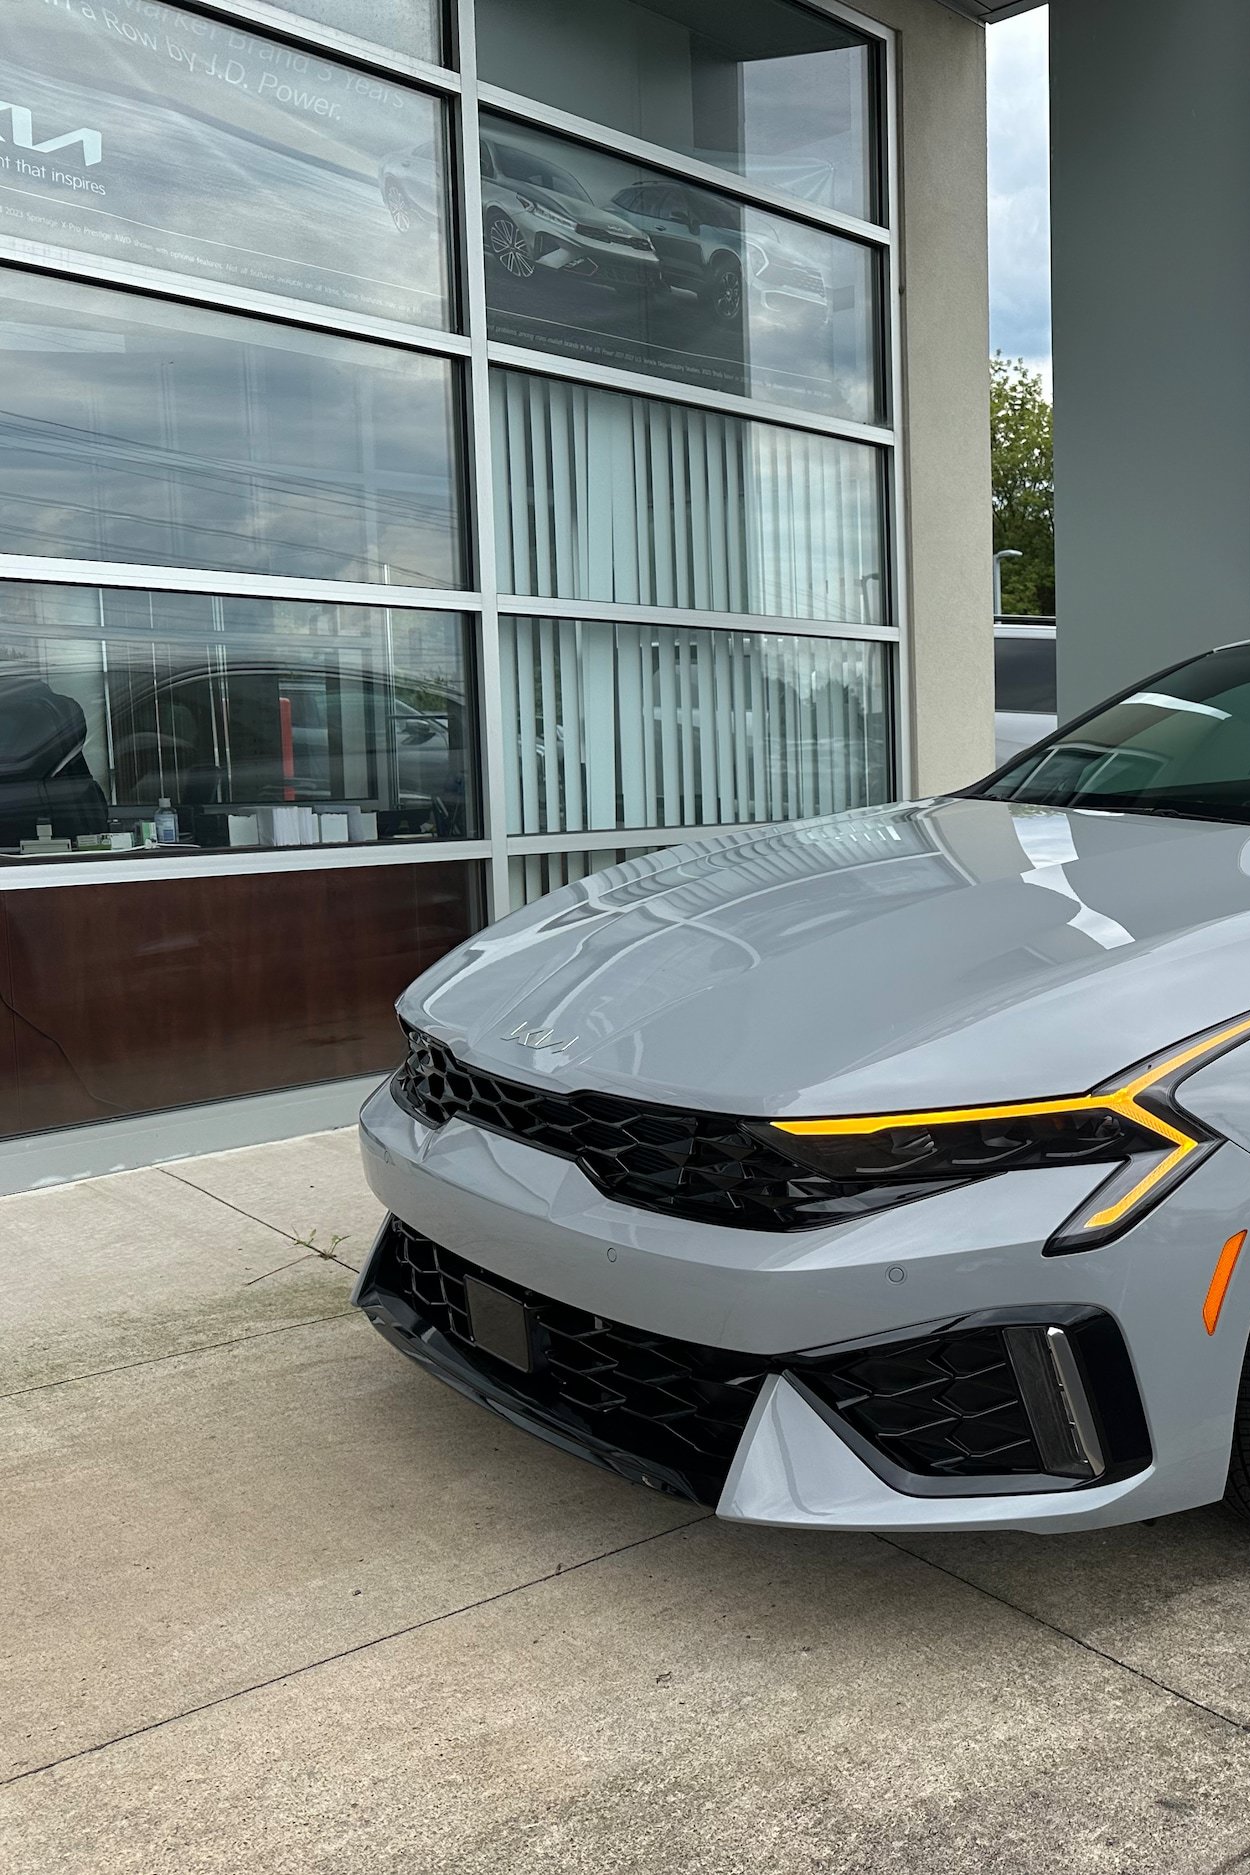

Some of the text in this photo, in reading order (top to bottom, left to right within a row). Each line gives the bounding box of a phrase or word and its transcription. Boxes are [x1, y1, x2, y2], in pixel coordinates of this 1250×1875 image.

[80, 0, 97, 21] a
[102, 7, 157, 51] Row
[165, 35, 197, 72] by
[204, 53, 249, 90] J.D.
[257, 71, 342, 121] Power.
[15, 158, 47, 179] that
[51, 167, 106, 196] inspires
[501, 1021, 579, 1055] KIA
